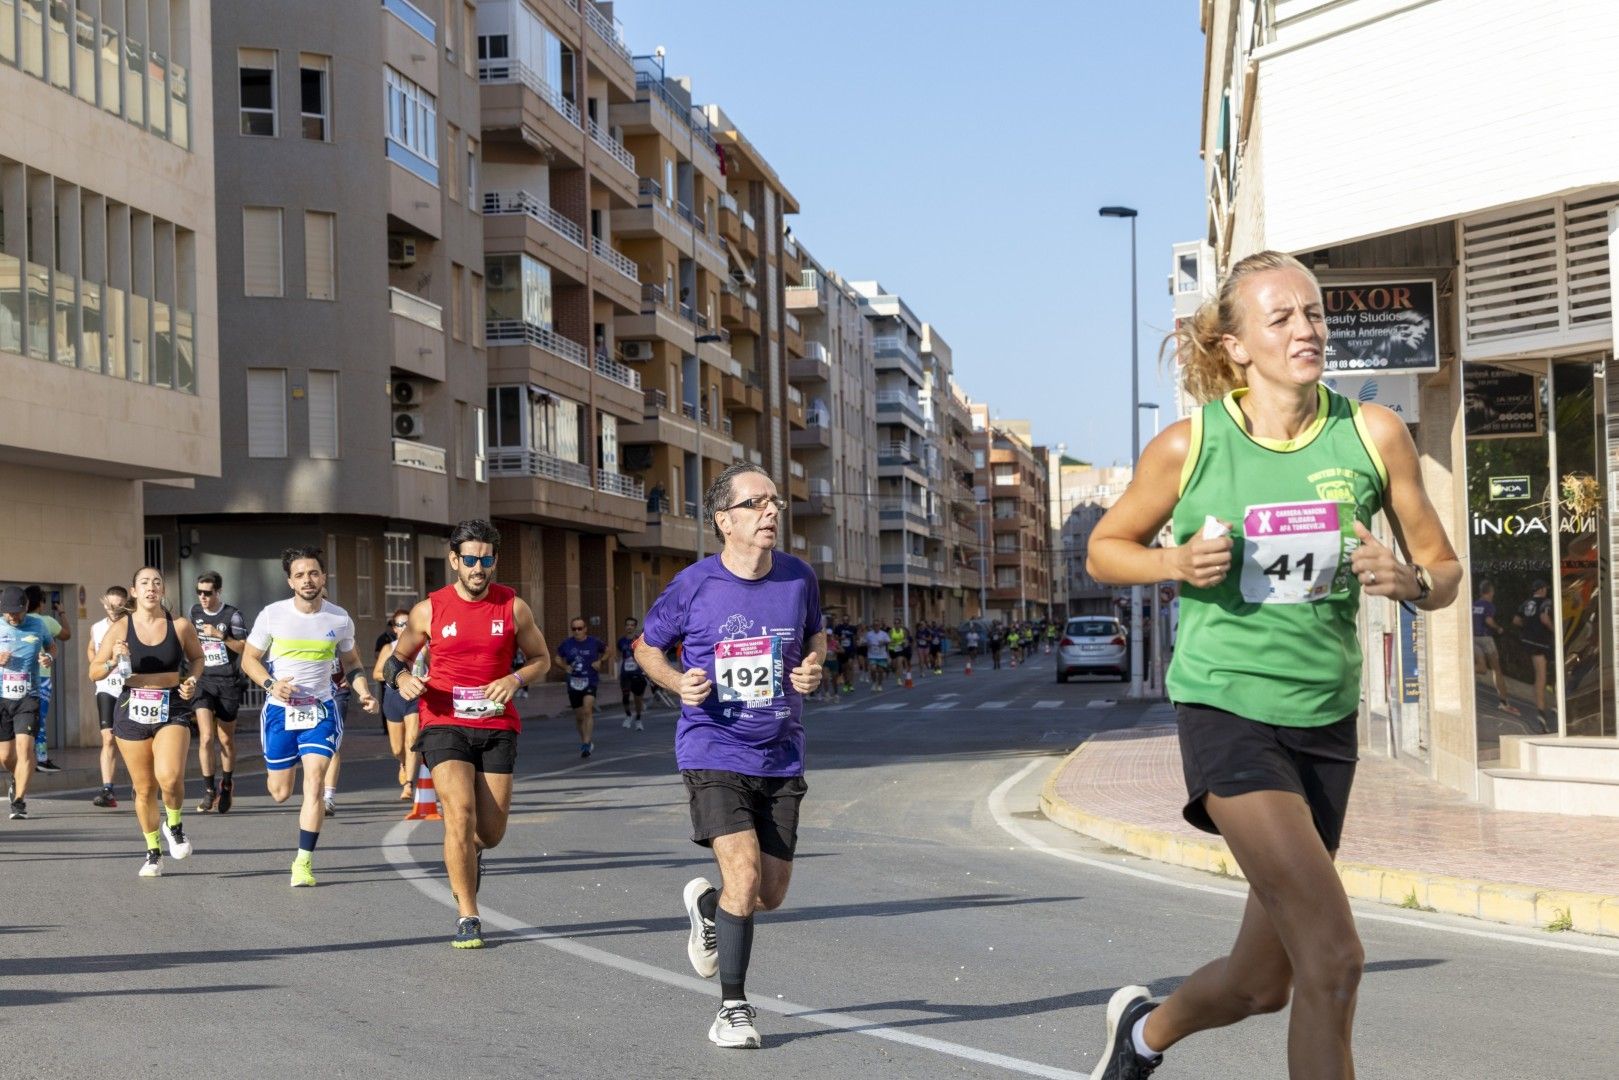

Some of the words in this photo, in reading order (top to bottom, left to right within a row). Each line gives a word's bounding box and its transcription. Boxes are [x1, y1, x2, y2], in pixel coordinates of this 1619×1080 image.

[1325, 287, 1414, 312] UXOR
[1326, 313, 1356, 325] eauty
[1263, 552, 1314, 581] 41
[774, 659, 782, 678] KM
[107, 678, 122, 686] 181
[721, 666, 769, 688] 192
[5, 684, 25, 693] 149
[132, 705, 159, 717] 198
[289, 710, 315, 723] 184
